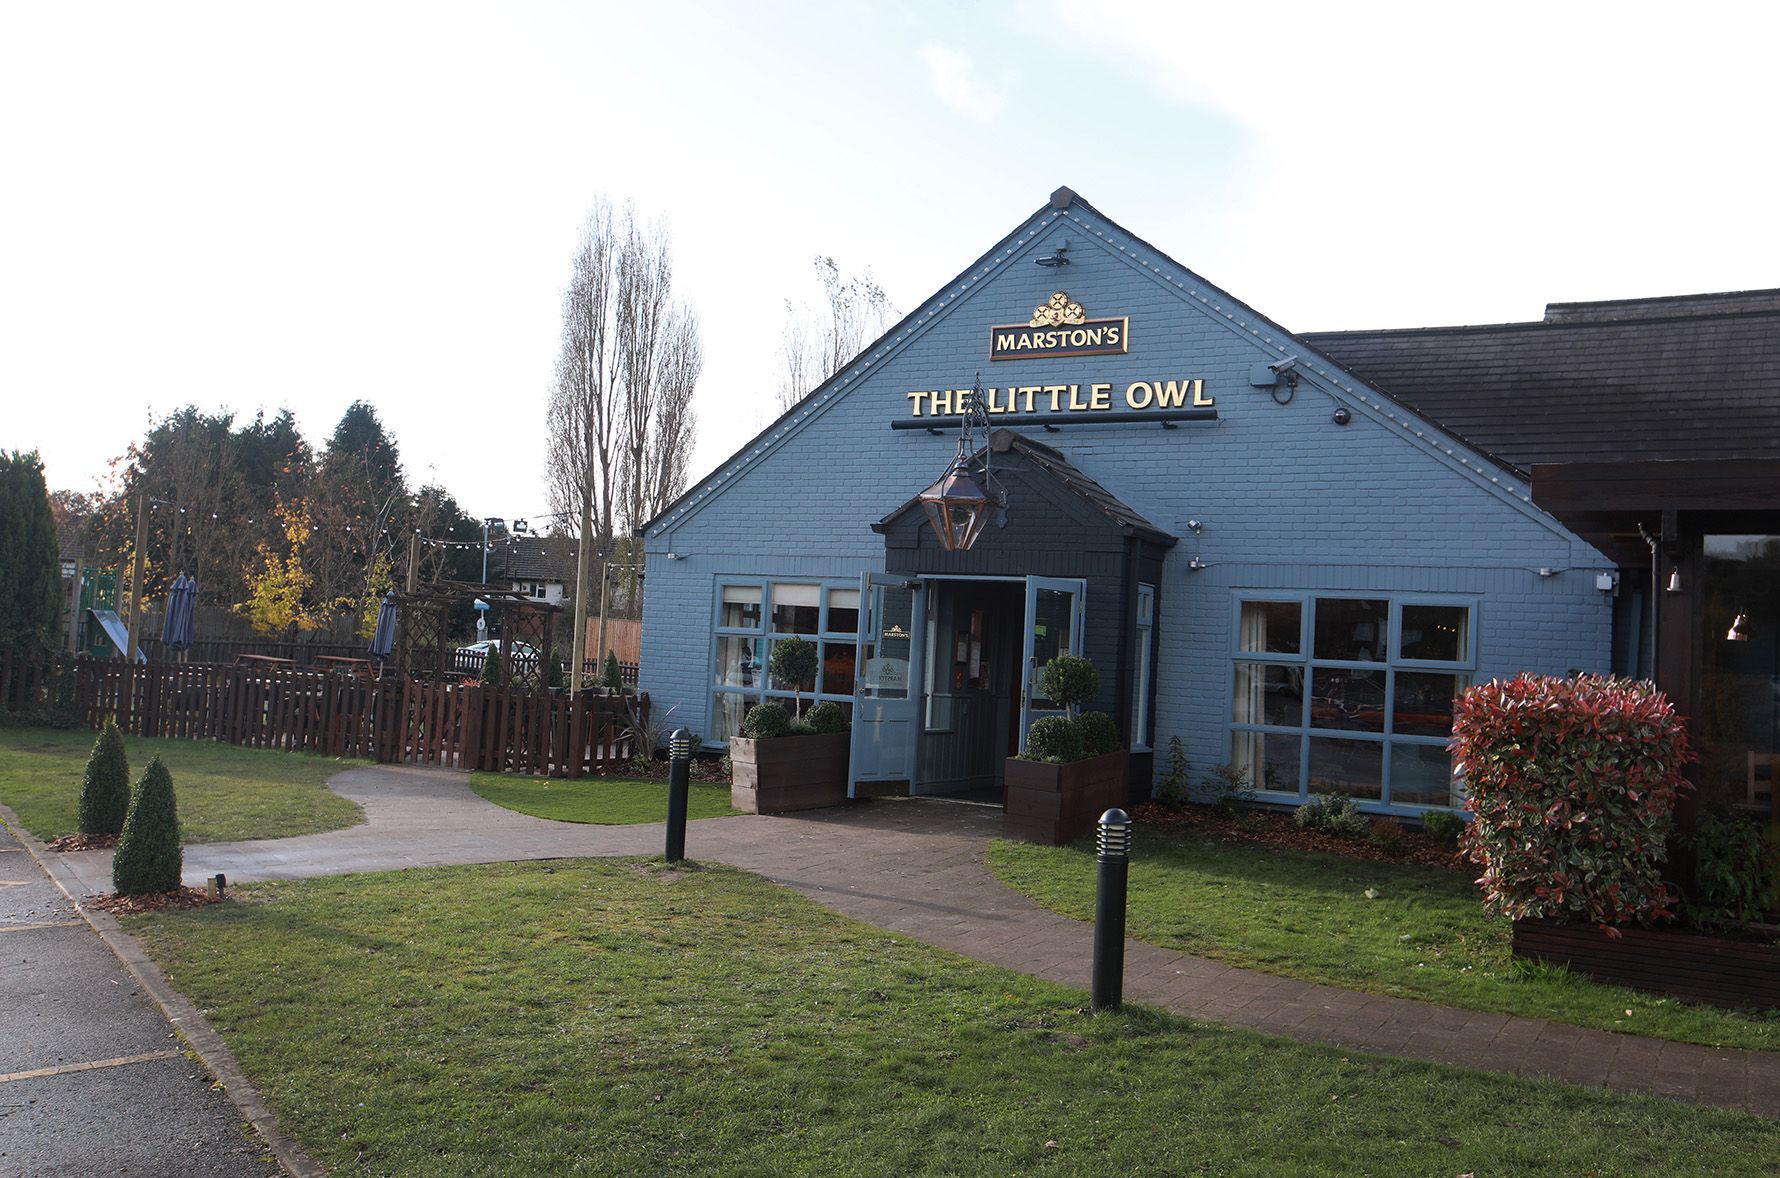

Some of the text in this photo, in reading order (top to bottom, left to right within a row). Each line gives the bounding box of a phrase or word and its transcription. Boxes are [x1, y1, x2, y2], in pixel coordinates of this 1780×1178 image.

[996, 327, 1120, 350] MARSTON'S
[907, 379, 1215, 416] THE LITTLE OWL
